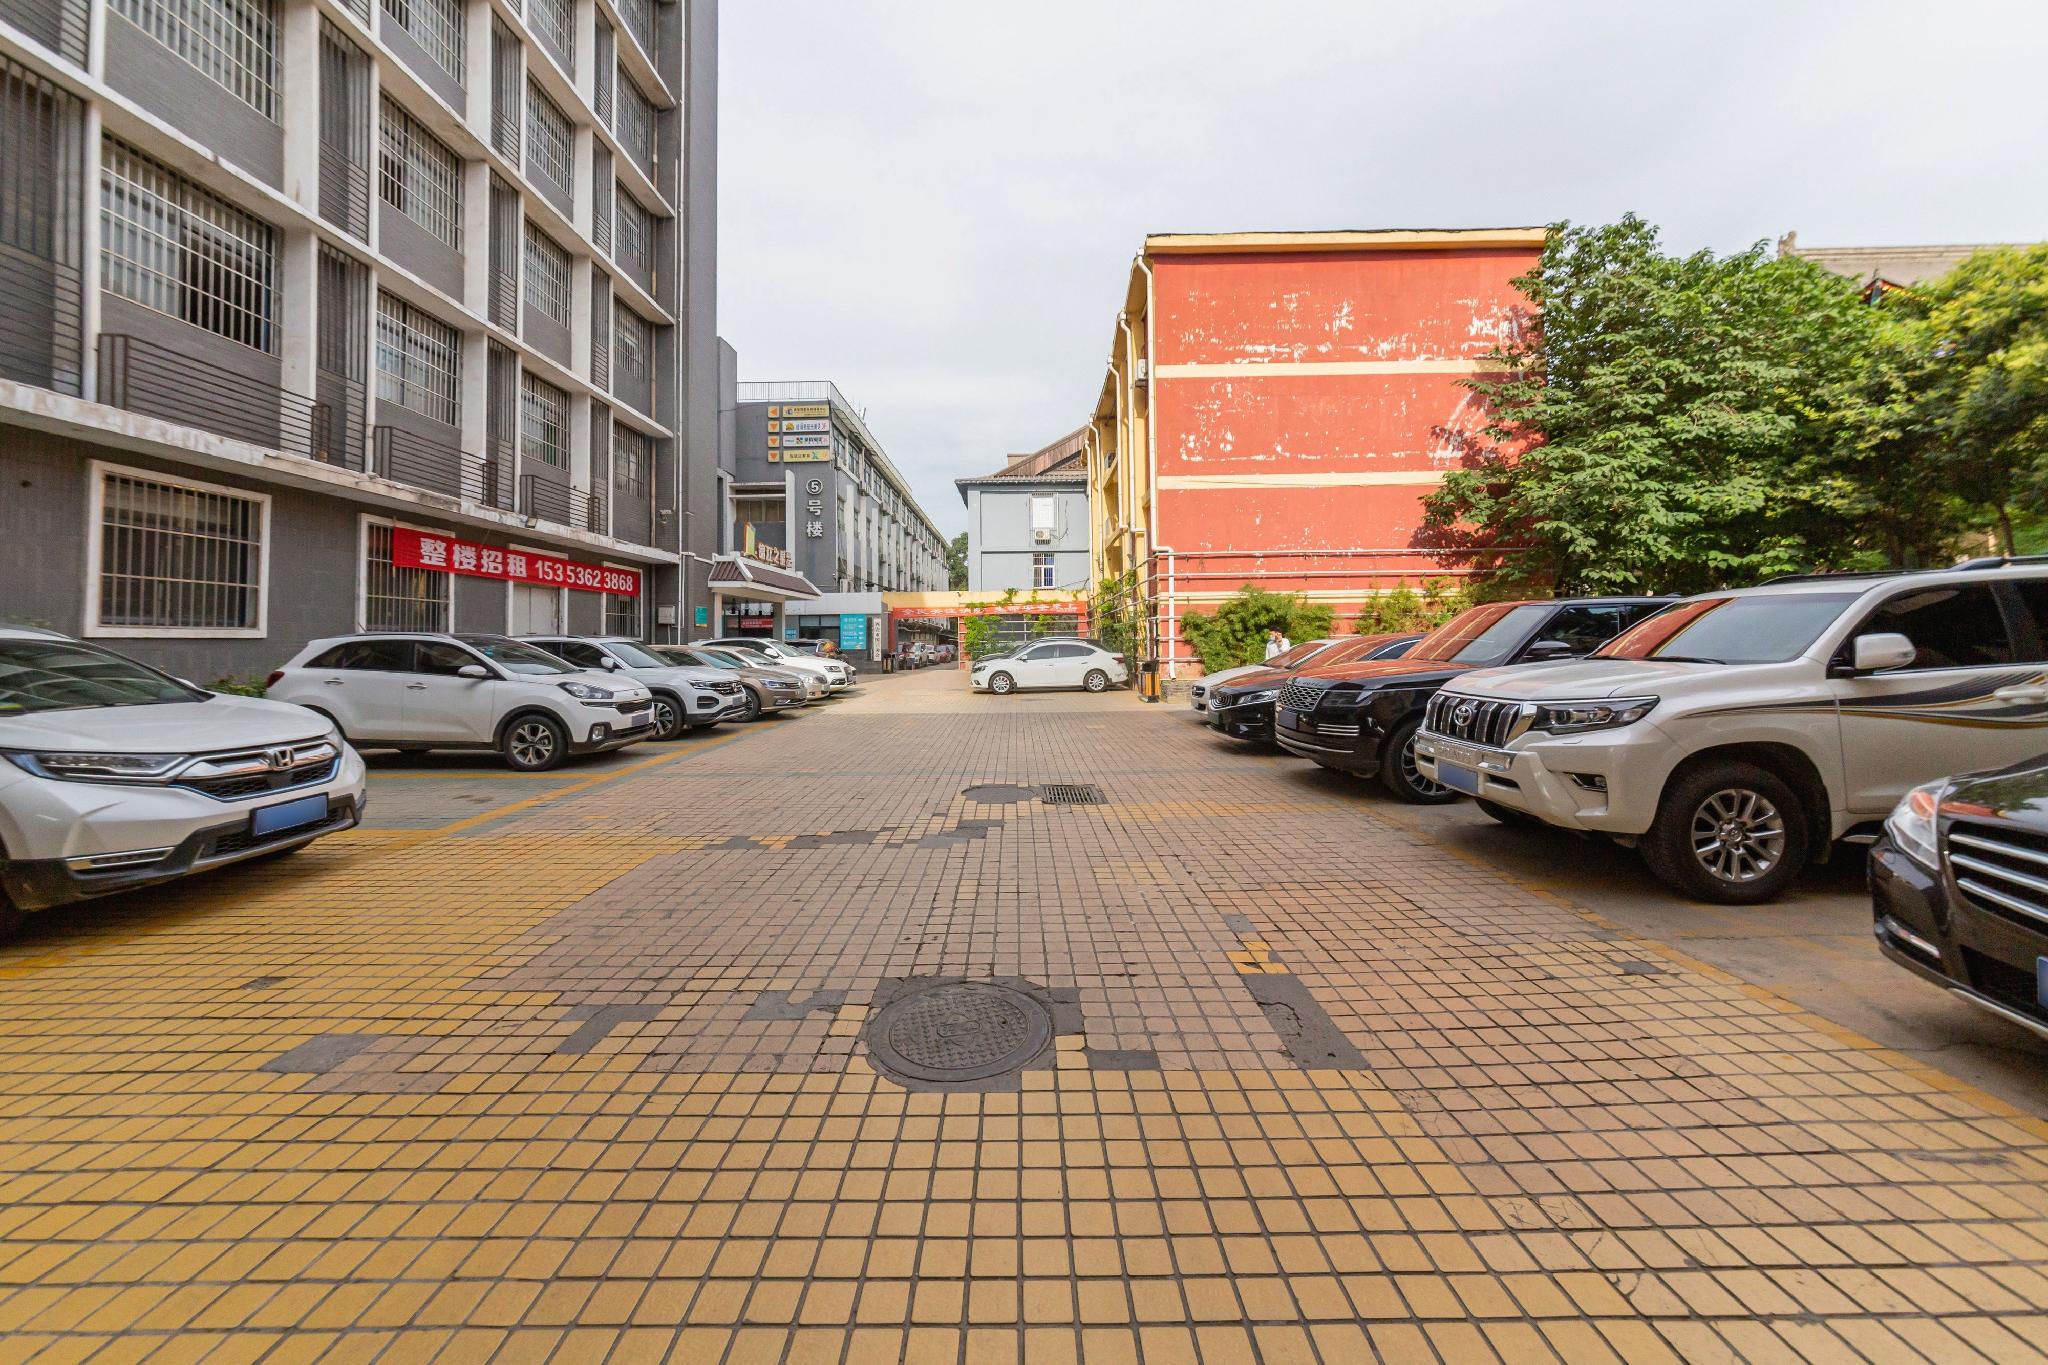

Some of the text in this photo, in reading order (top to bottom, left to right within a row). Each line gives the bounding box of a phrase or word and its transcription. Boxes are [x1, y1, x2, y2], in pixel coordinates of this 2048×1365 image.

[420, 537, 633, 592] 整楼招租 153 5362 3868
